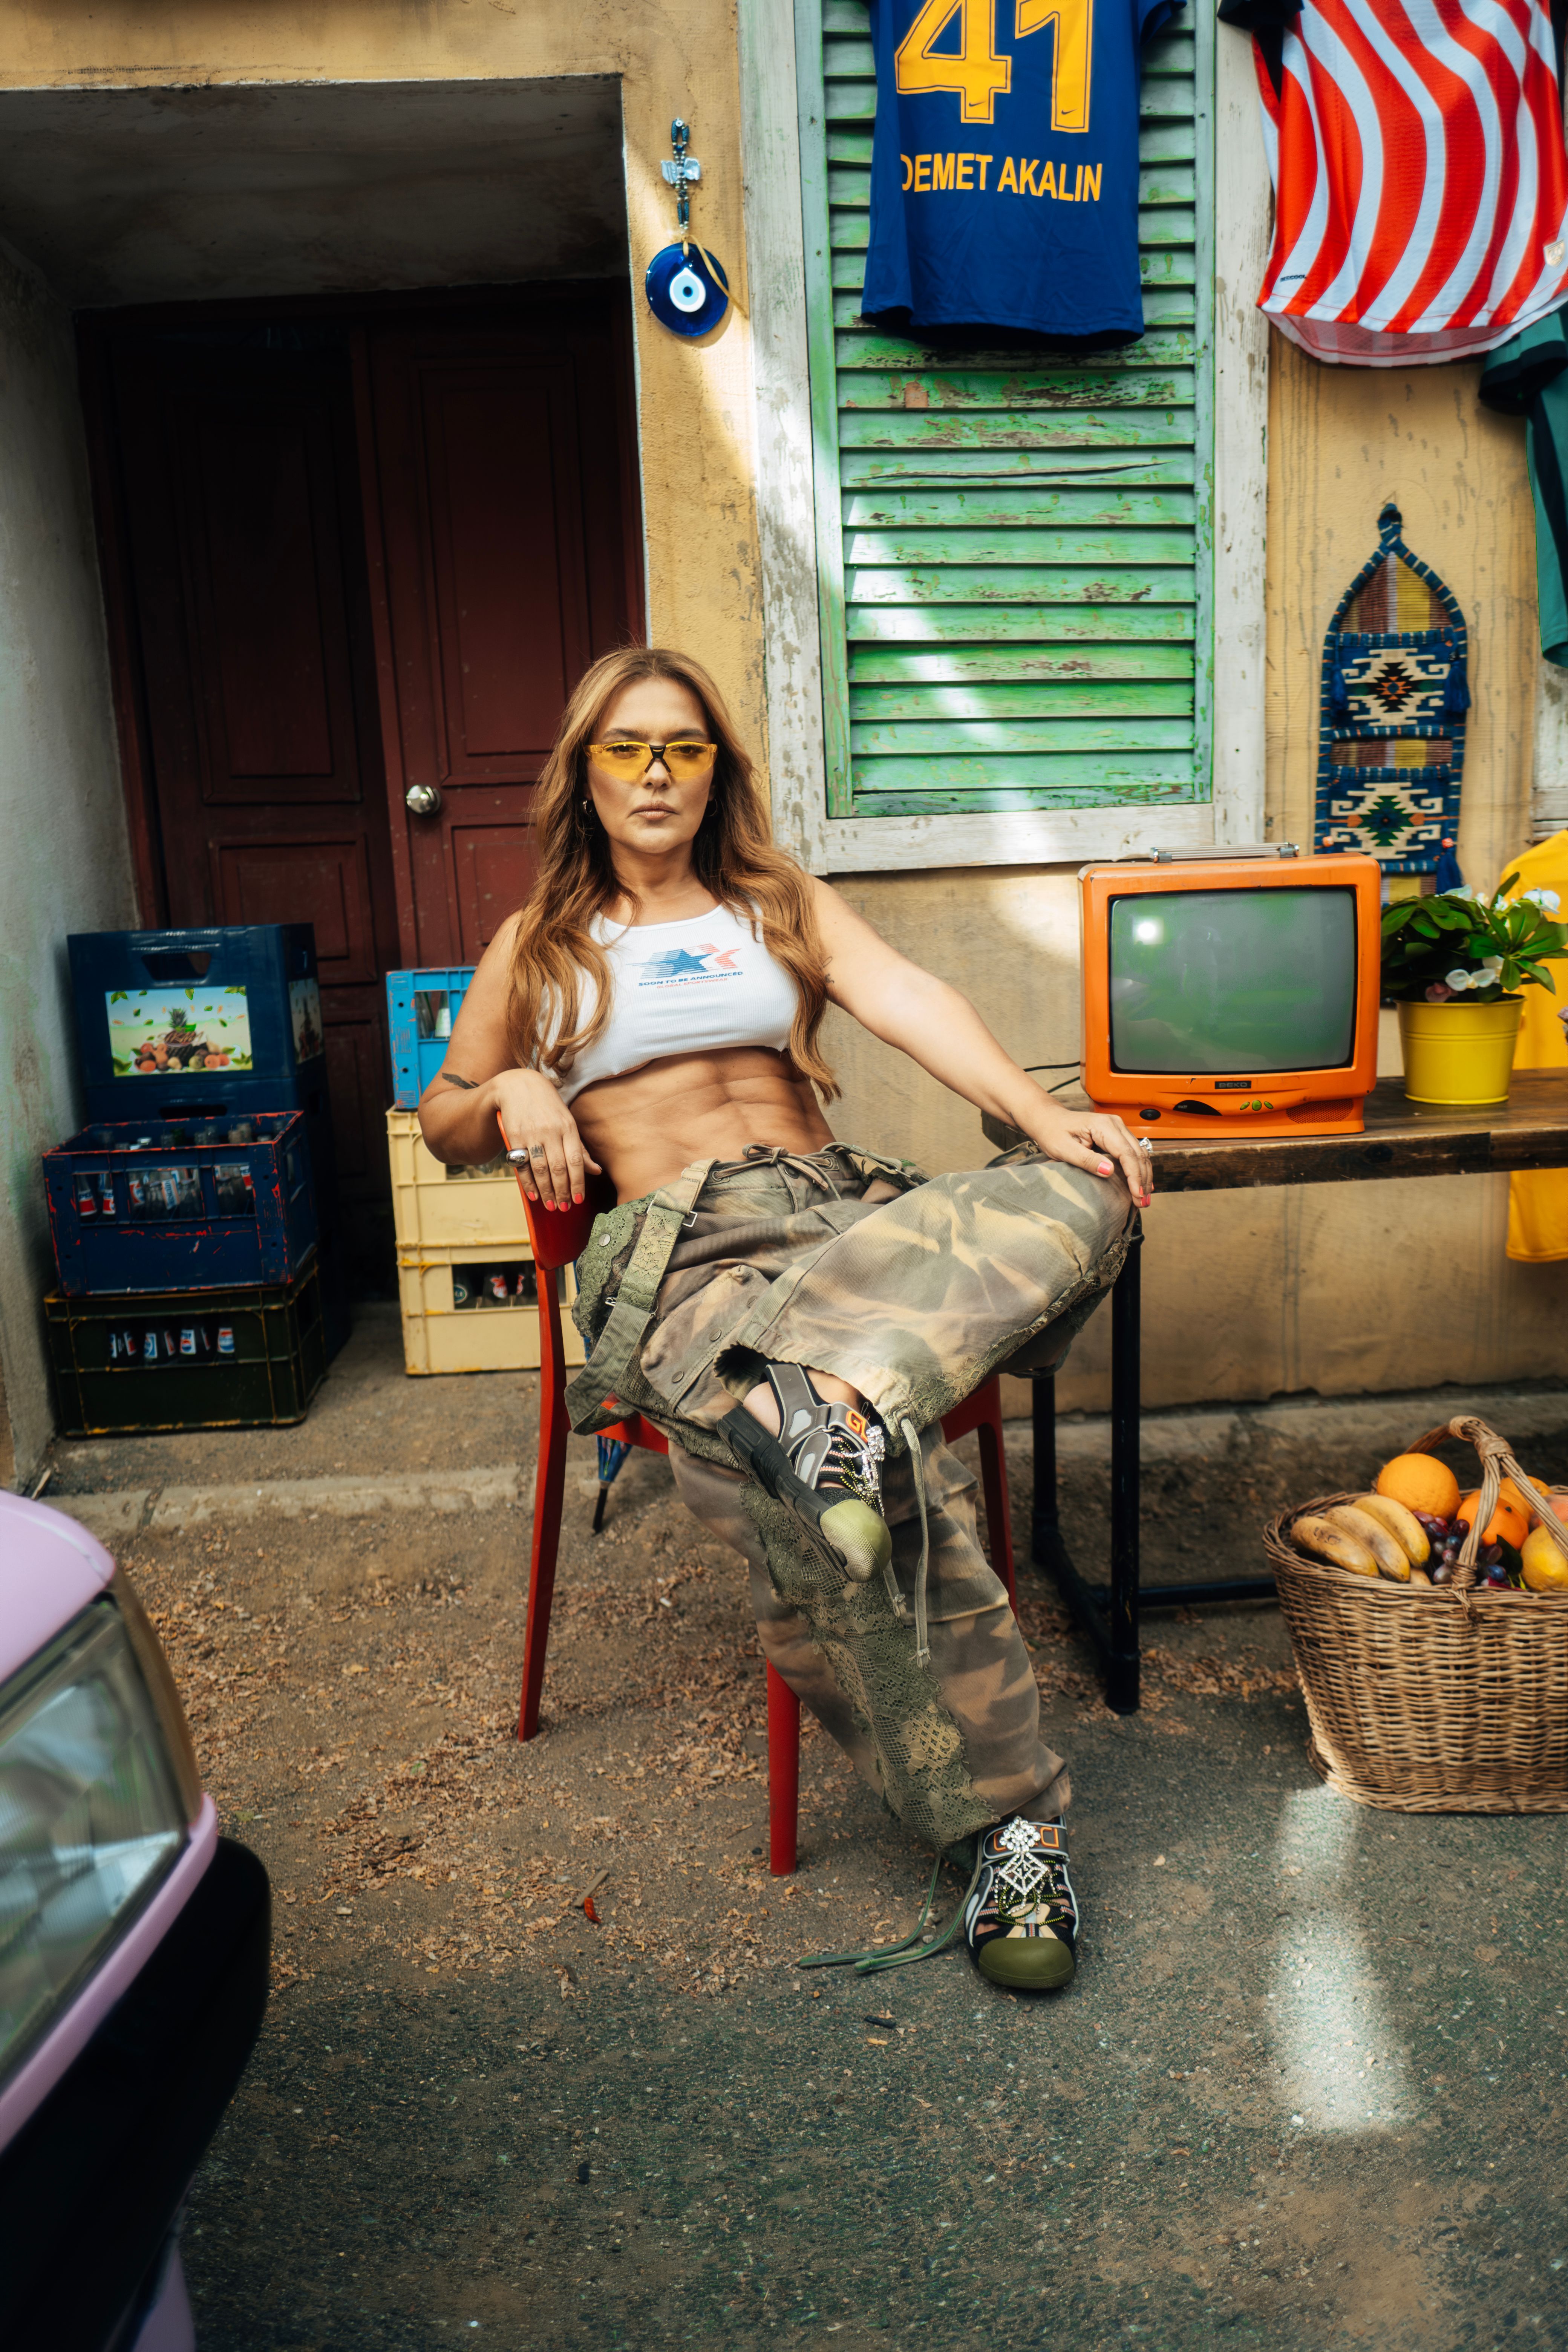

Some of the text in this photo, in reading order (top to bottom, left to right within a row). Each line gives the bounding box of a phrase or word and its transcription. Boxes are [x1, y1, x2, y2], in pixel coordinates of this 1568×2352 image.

[894, 0, 1093, 133] 41
[900, 153, 1102, 202] DEMET AKALIN
[690, 971, 743, 980] ANNOUNCED
